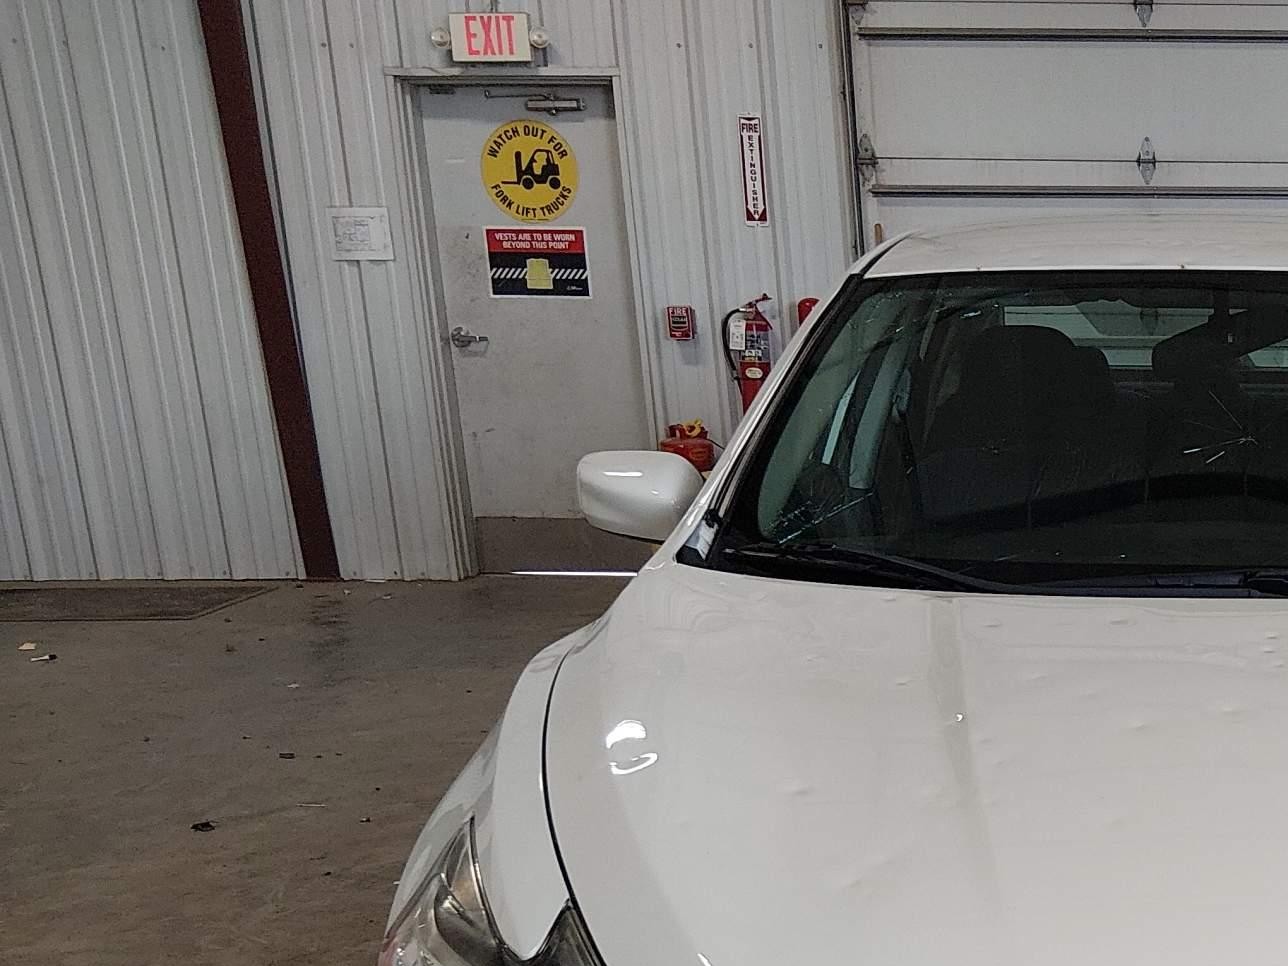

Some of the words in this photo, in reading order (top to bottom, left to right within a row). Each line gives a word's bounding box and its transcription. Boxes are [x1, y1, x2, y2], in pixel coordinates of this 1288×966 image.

[464, 15, 515, 56] EXIT
[741, 122, 759, 134] FIRE
[487, 126, 521, 159] WATCH
[523, 124, 548, 140] OUT
[547, 135, 569, 160] FOR
[747, 134, 760, 217] EXTINGUISHER
[490, 183, 515, 211] FORK
[515, 204, 537, 218] LIFT
[539, 185, 572, 217] TRUCKS
[494, 232, 517, 241] VESTS
[518, 233, 532, 241] ARE
[532, 233, 543, 241] TO
[543, 233, 553, 241] BE
[553, 233, 576, 242] WORN
[502, 240, 531, 249] BEYOND
[531, 241, 548, 249] THIS
[548, 241, 570, 249] POINT
[668, 307, 688, 317] FIRE
